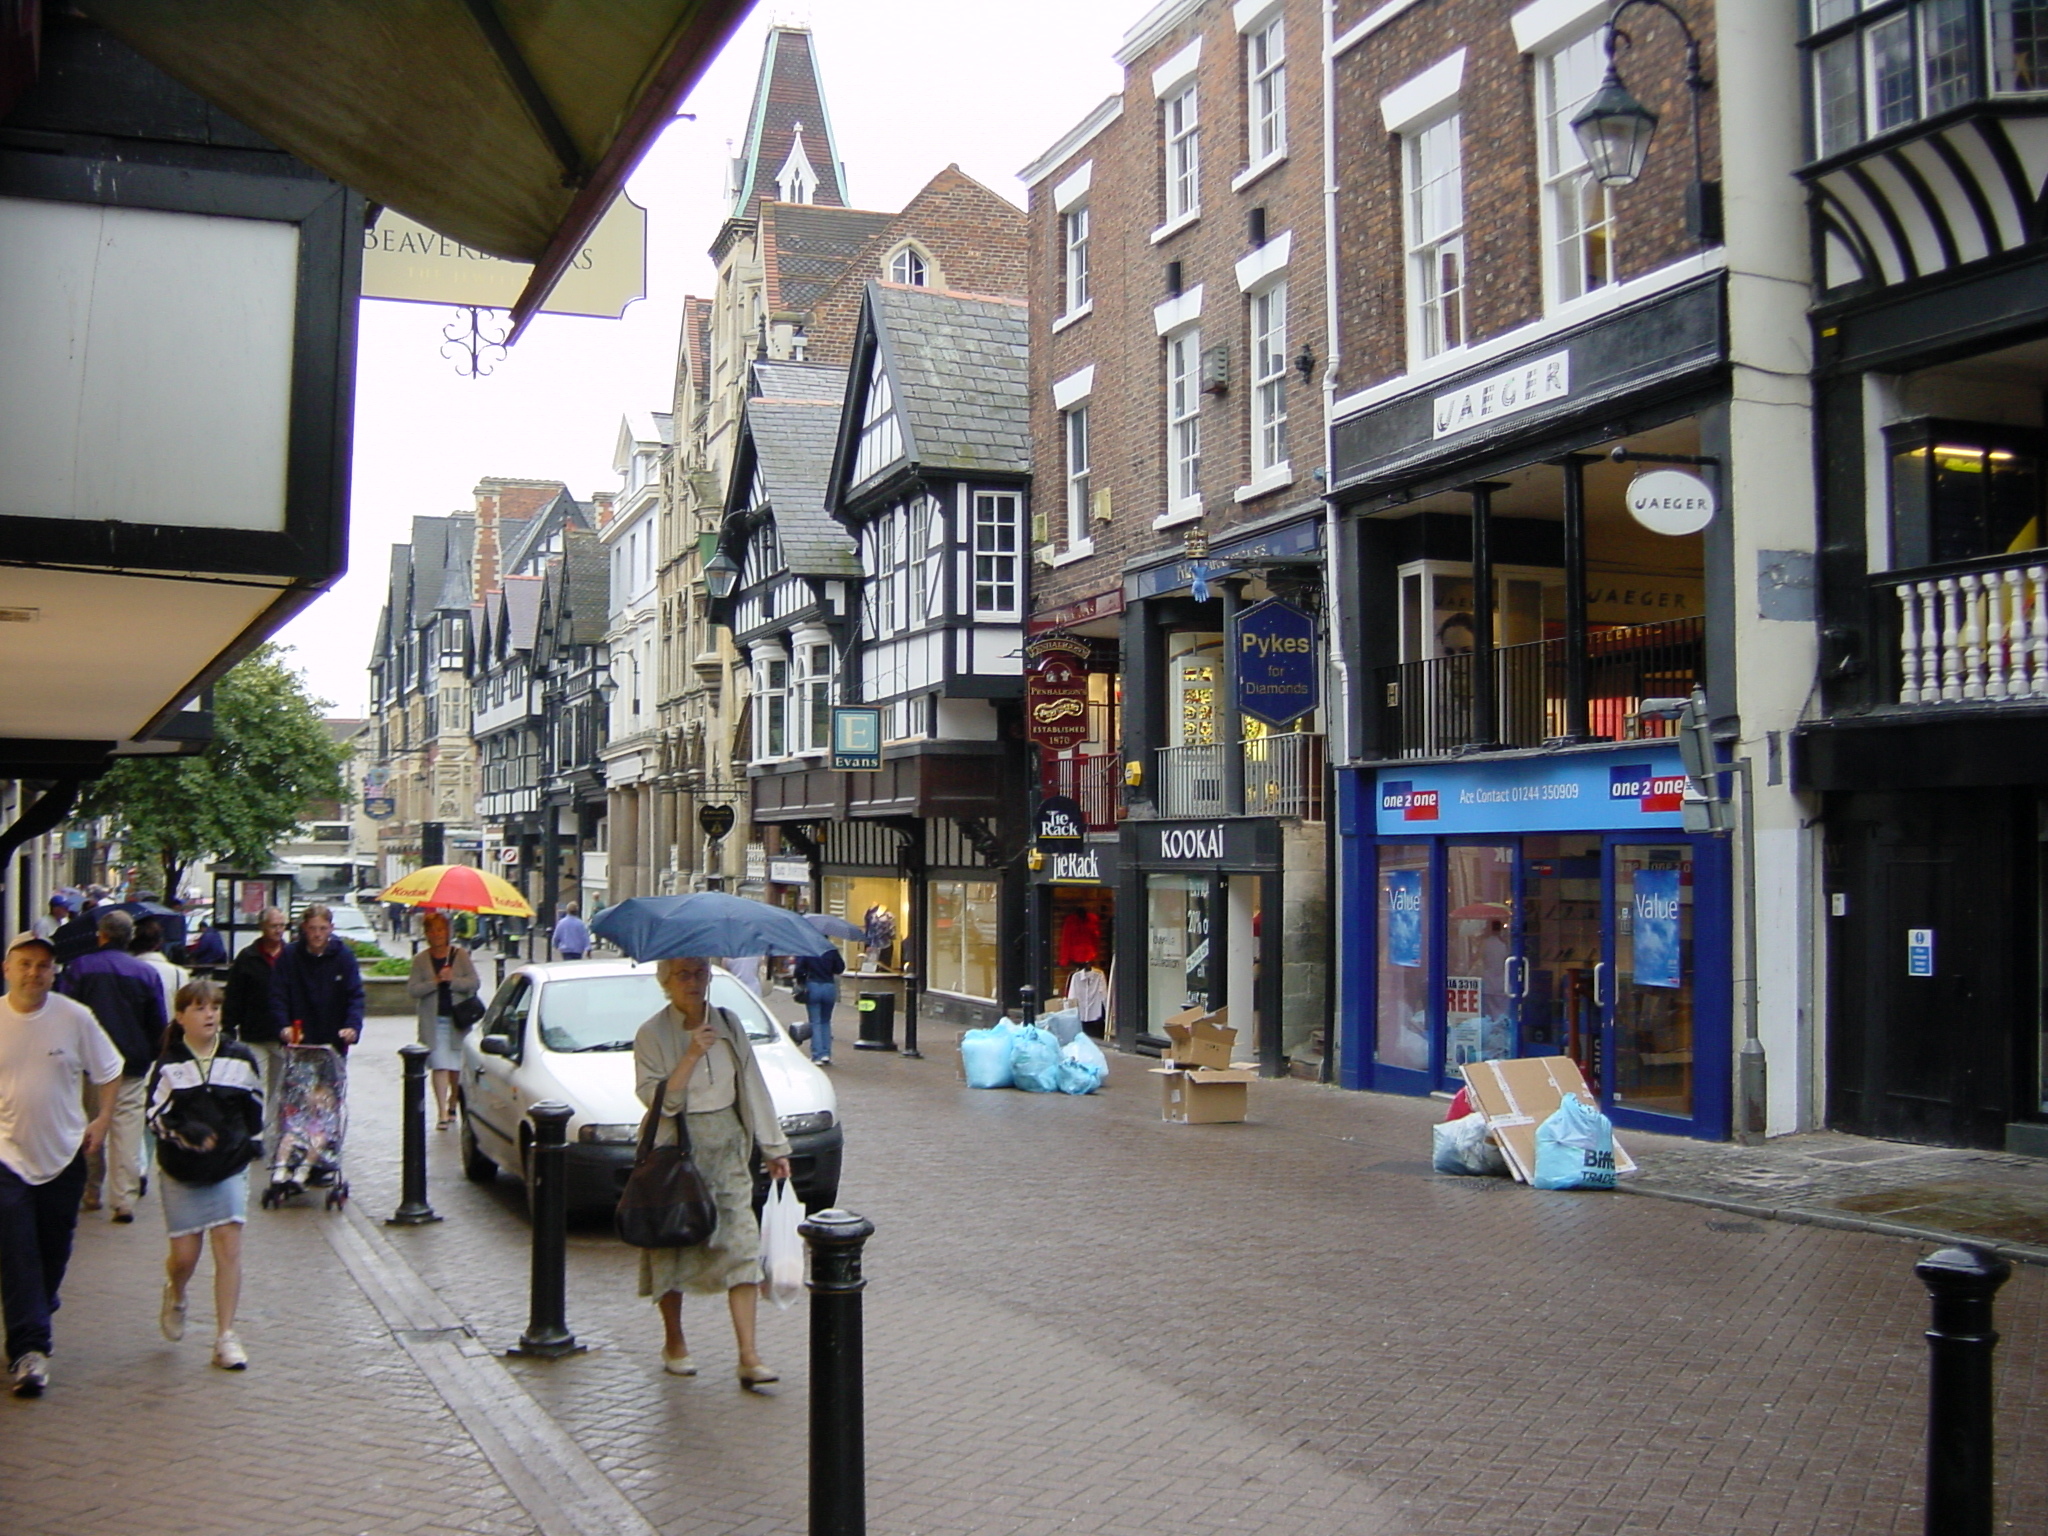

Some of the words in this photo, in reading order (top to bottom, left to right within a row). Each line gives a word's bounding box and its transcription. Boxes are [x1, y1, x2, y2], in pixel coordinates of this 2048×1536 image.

[1436, 361, 1562, 433] JAEGER
[1635, 498, 1707, 510] JAEGER
[1585, 588, 1686, 608] JAEGER
[1242, 632, 1310, 658] Pykes
[1268, 665, 1284, 677] for
[1246, 682, 1309, 695] Diamonds
[842, 716, 869, 749] E
[1049, 736, 1070, 745] 1870
[835, 757, 878, 767] Evans
[1459, 789, 1475, 804] Ace
[1476, 788, 1510, 803] Contact
[1512, 786, 1539, 801] 01244
[1542, 783, 1579, 800] 350909
[1612, 782, 1640, 797] one
[1642, 781, 1651, 796] 2
[1654, 779, 1685, 795] one
[1383, 795, 1402, 808] one
[1404, 795, 1412, 807] 2
[1414, 793, 1437, 806] one
[1046, 810, 1069, 826] Tie
[1041, 821, 1078, 836] Rack
[390, 887, 429, 897] Kodak
[1389, 889, 1420, 911] Value
[1635, 892, 1679, 920] Value
[1446, 990, 1479, 1013] REE
